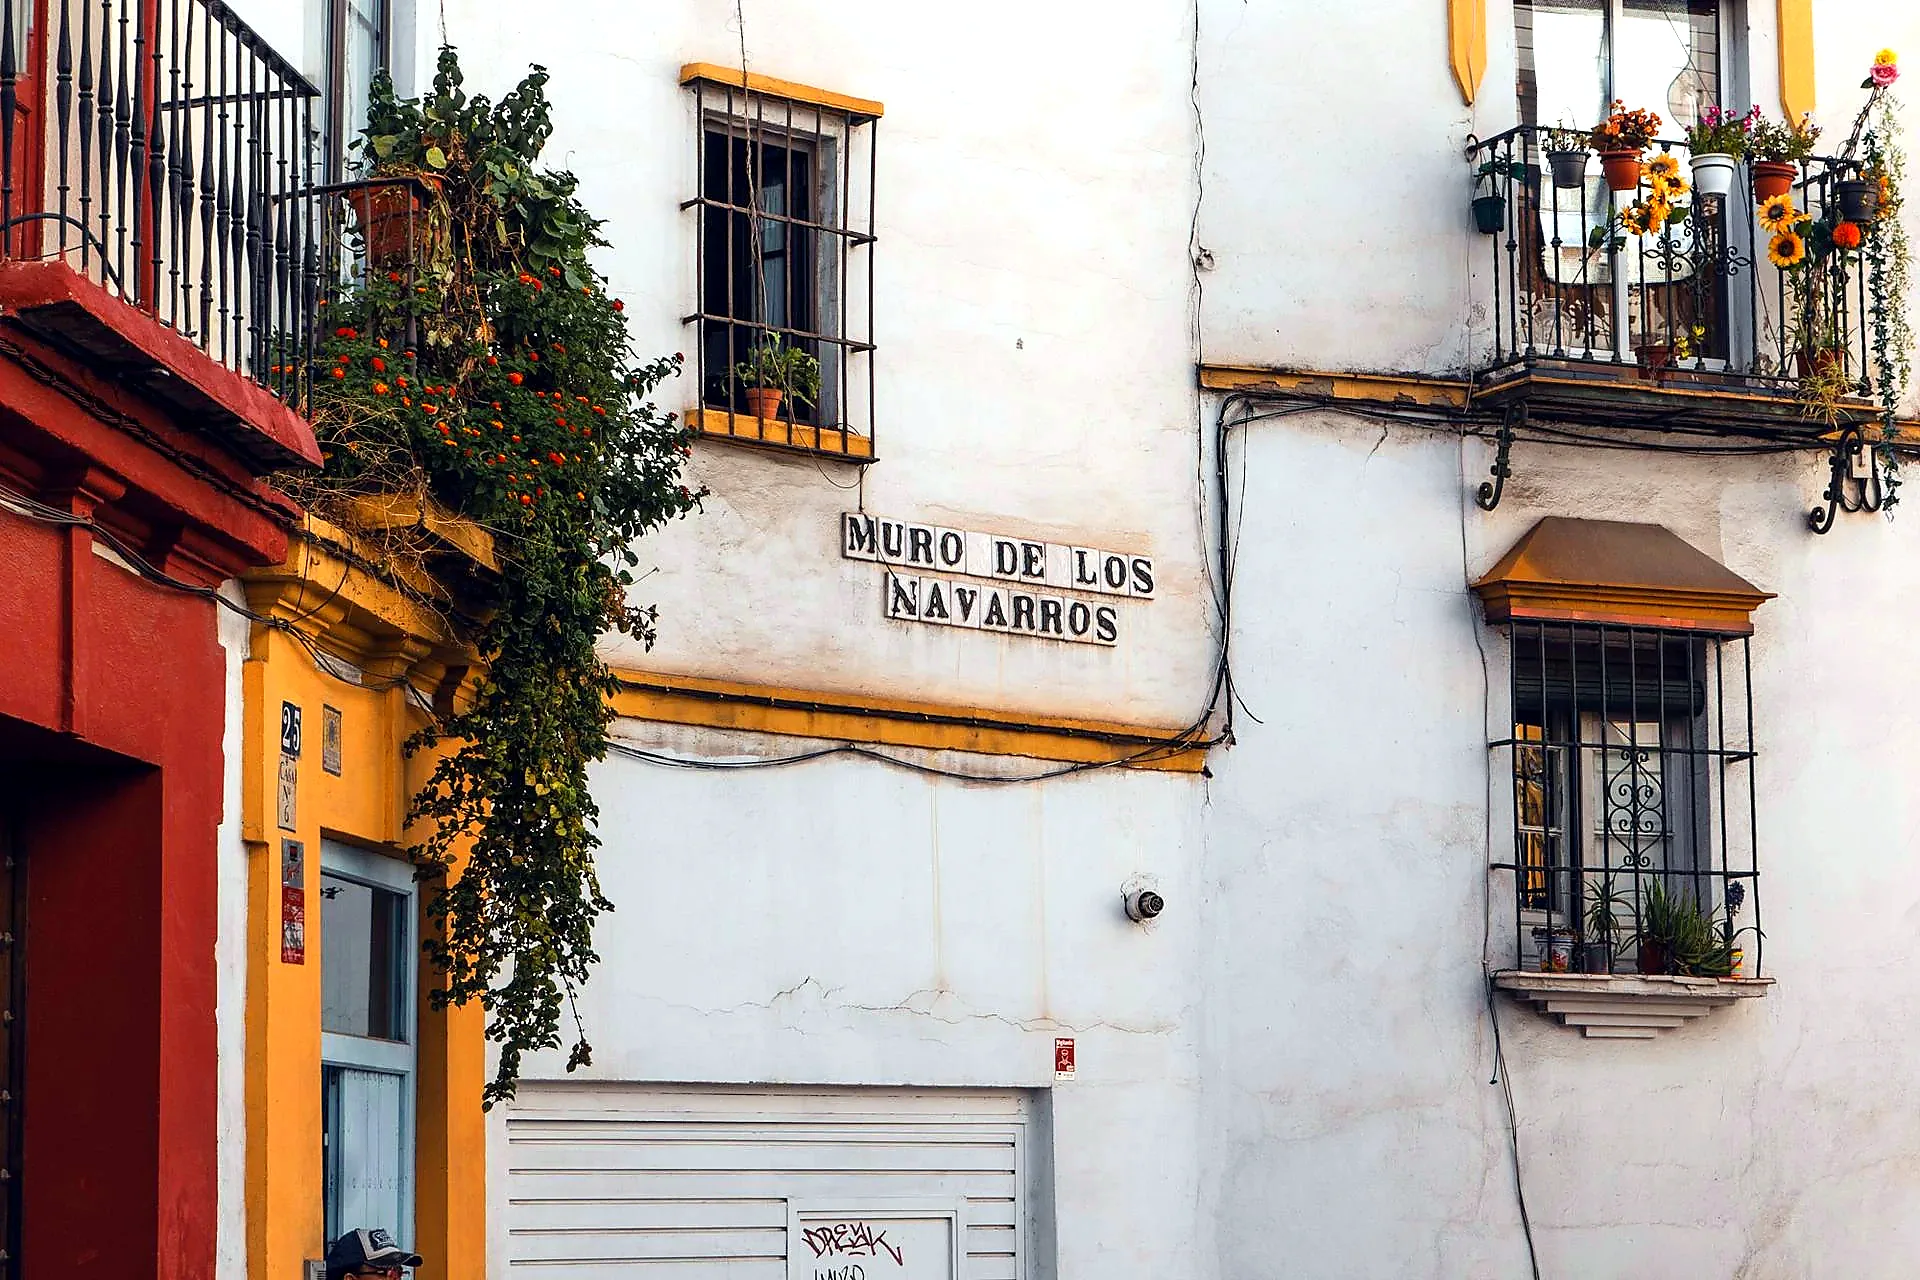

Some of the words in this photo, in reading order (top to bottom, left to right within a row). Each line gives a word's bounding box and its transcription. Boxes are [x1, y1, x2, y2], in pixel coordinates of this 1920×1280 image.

[848, 516, 963, 566] MURO
[995, 541, 1045, 578] DE
[1075, 550, 1154, 594] LOS
[891, 577, 1117, 642] NAVARROS
[282, 706, 300, 751] 25
